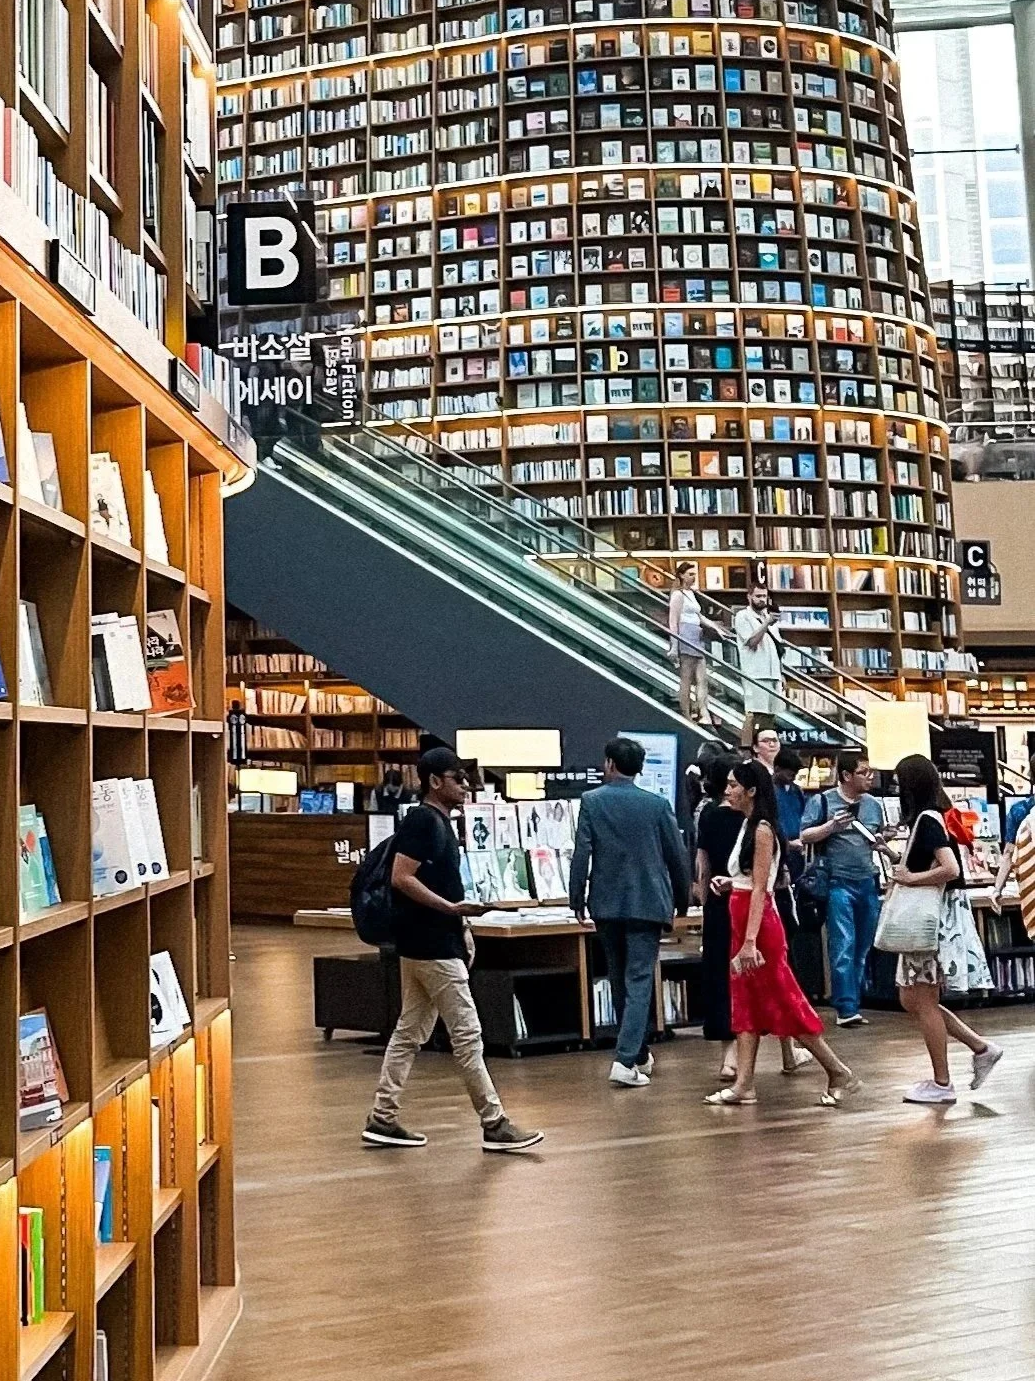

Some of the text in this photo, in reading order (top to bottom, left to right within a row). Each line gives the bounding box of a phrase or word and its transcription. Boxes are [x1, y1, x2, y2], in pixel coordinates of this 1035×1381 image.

[245, 216, 300, 291] B
[238, 373, 313, 406] 에세이
[323, 344, 340, 397] Essay
[340, 323, 356, 421] Non-Fiction
[967, 545, 984, 567] C
